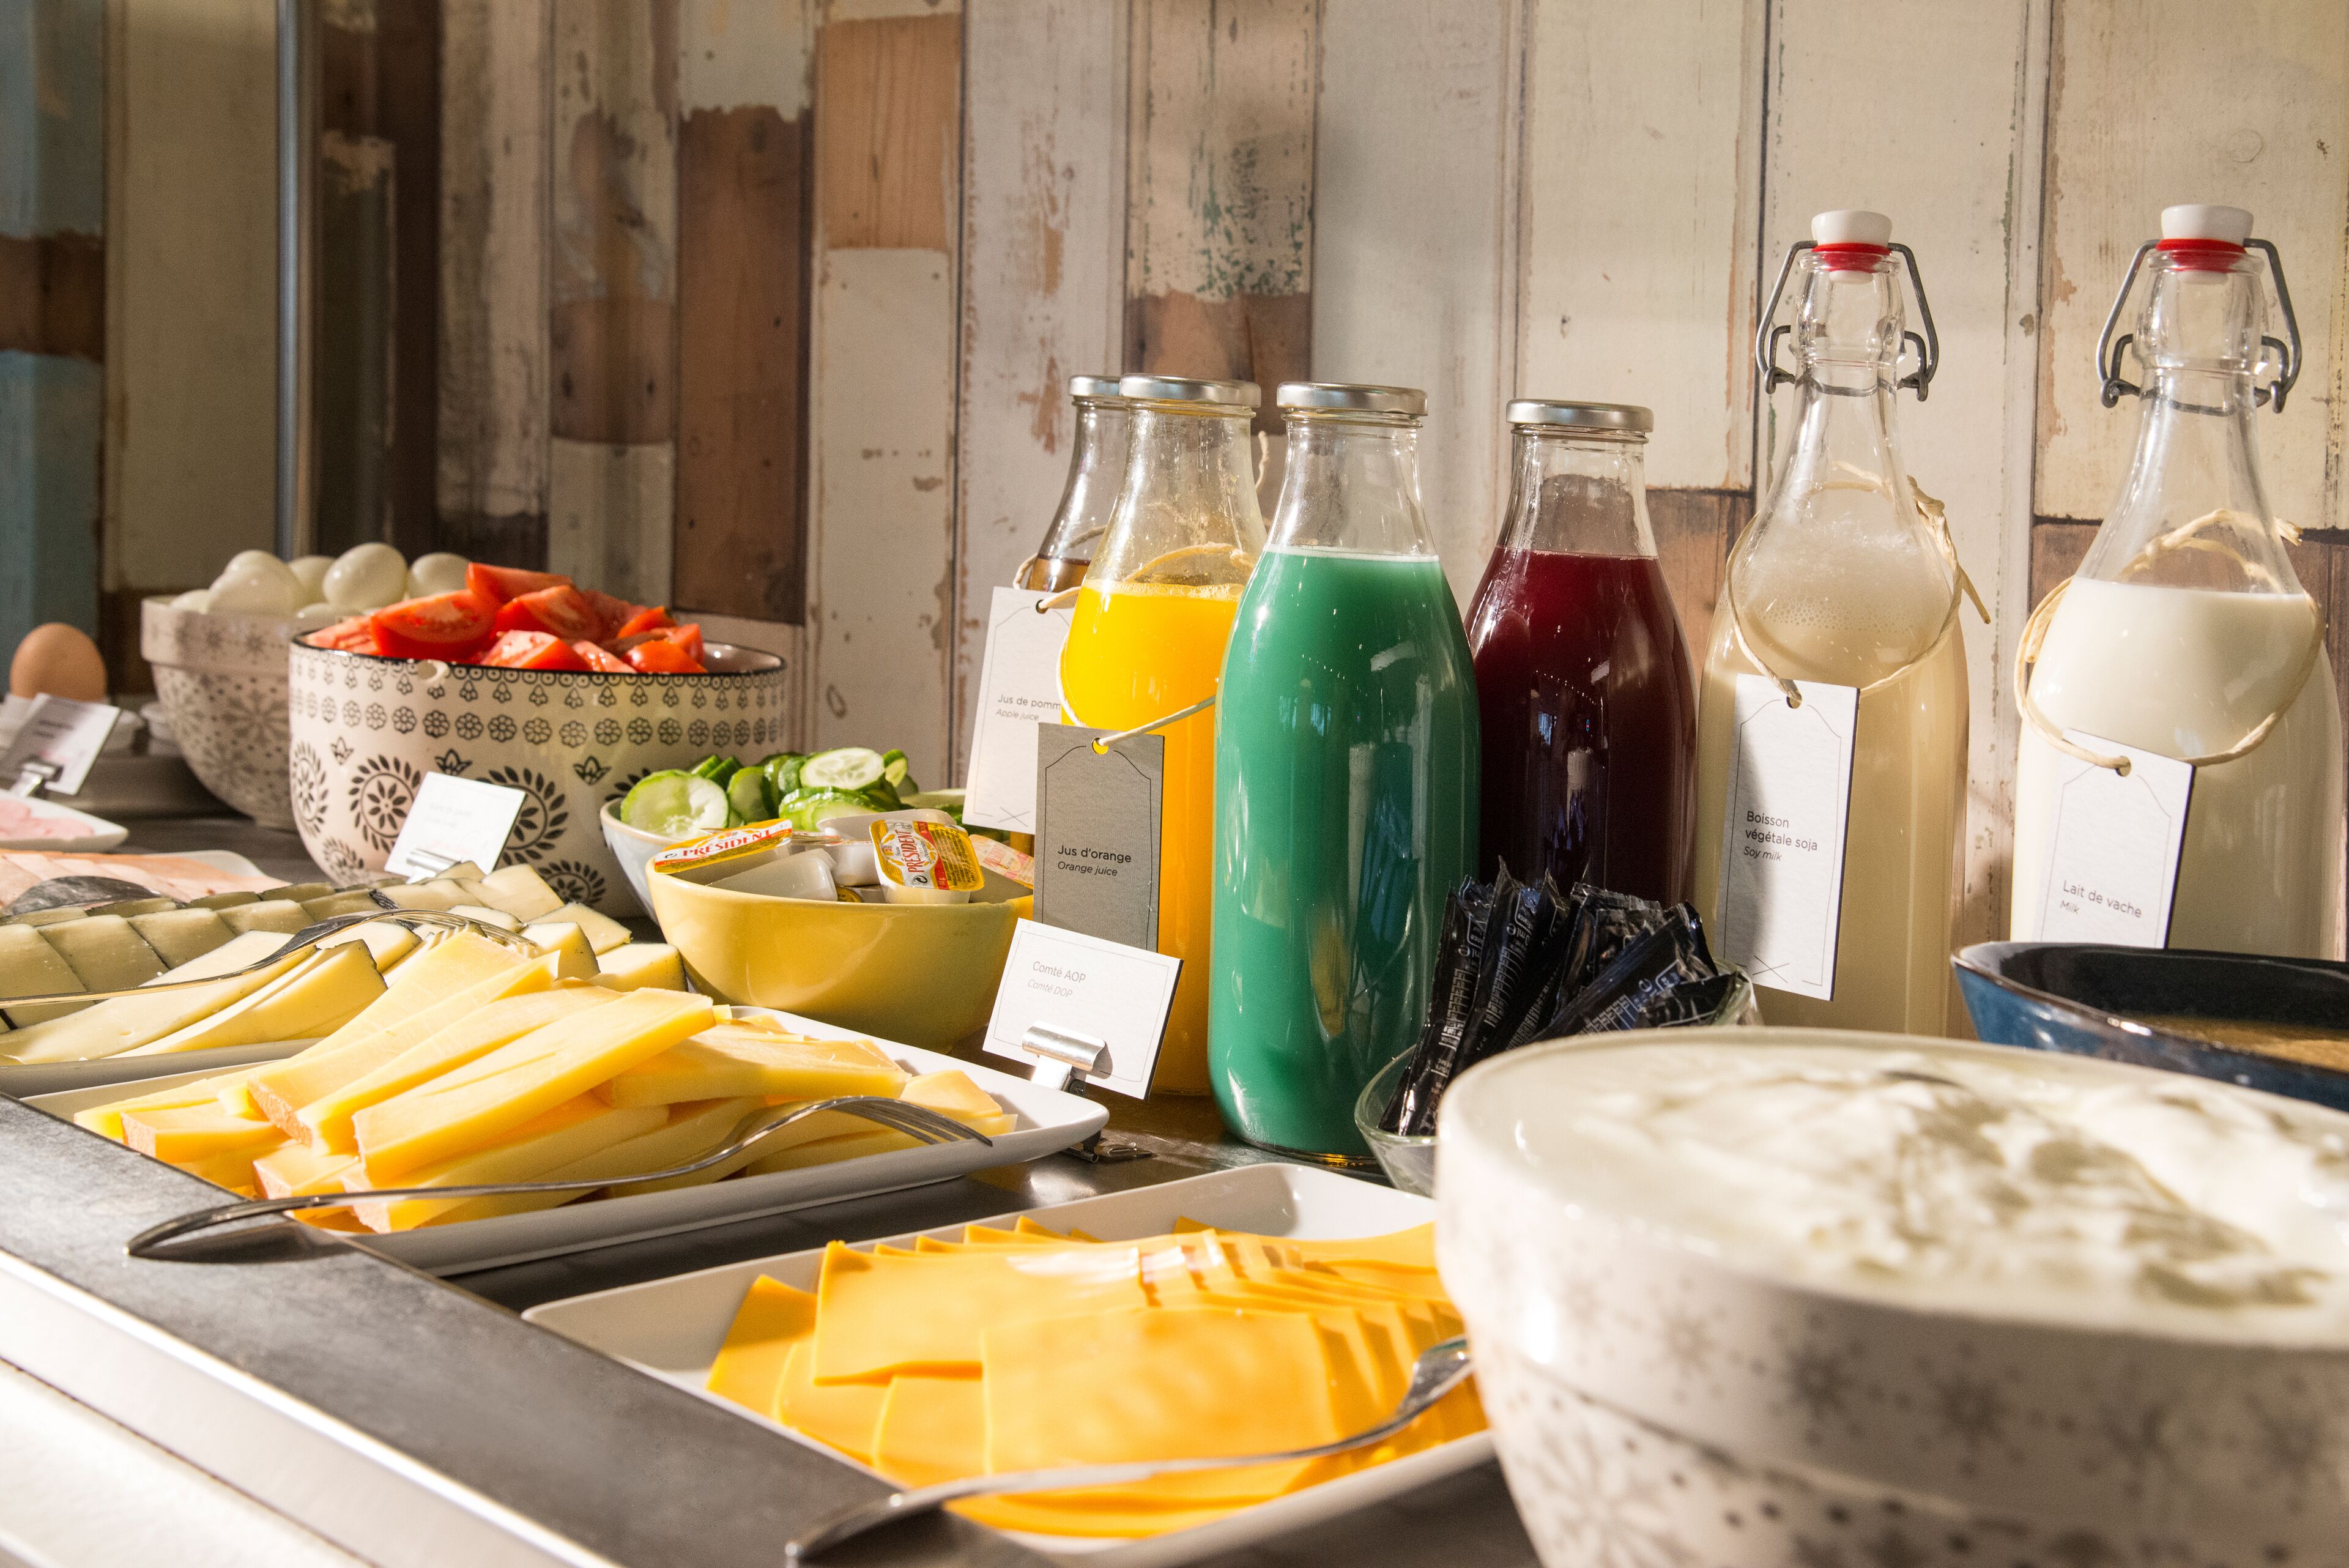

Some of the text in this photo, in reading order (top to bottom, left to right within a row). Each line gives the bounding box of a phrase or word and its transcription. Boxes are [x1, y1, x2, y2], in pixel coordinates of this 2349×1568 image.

[998, 694, 1061, 710] Jus de pomm
[996, 708, 1039, 721] Apple juice
[1746, 811, 1789, 828] Boisson
[1745, 828, 1817, 851] végétale soja
[895, 830, 925, 872] PRÉSIDENT
[1058, 845, 1131, 863] Jus d'orange
[1743, 846, 1783, 861] Soy milk
[1058, 861, 1118, 876] Orange juice
[2060, 900, 2080, 915] Milk
[2063, 880, 2142, 918] Lait de vache
[1033, 961, 1086, 983] Comté AOP
[1028, 979, 1073, 997] Comté DOP
